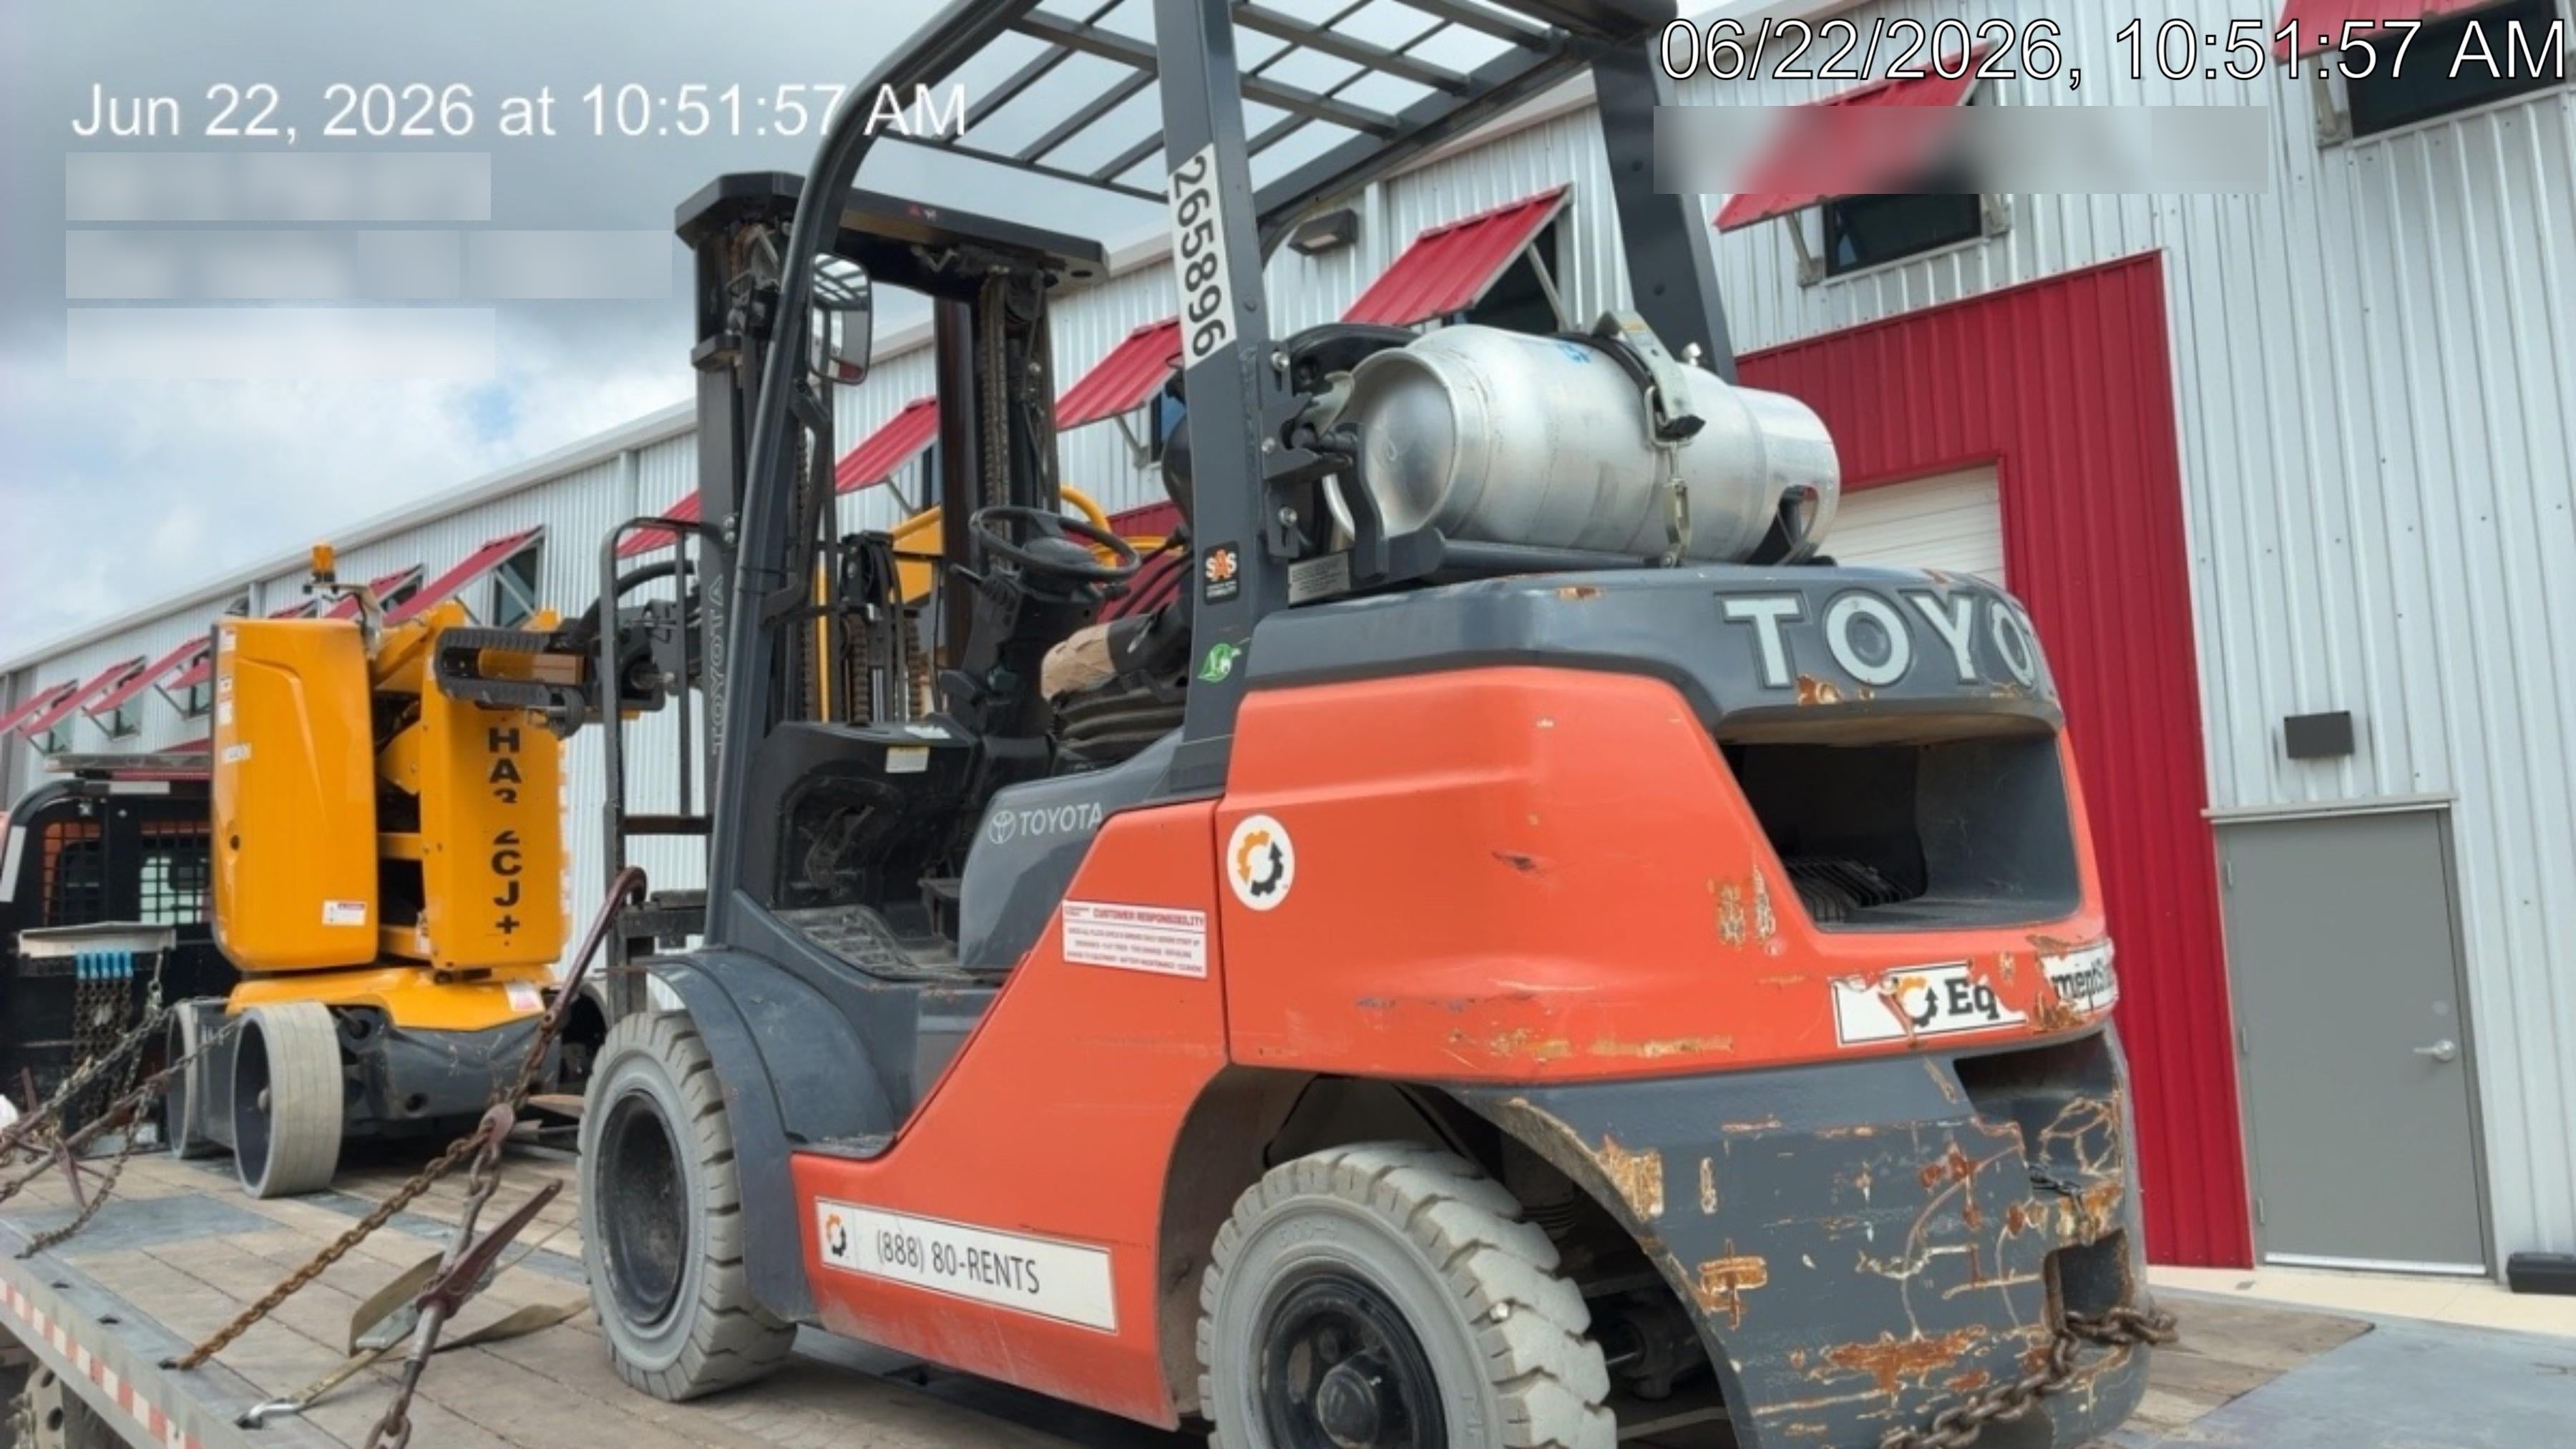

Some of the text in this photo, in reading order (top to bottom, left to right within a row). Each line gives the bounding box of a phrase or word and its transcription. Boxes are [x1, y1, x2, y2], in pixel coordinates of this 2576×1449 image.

[1174, 155, 1226, 357] 265896
[709, 574, 725, 756] TOYOTA
[1019, 801, 1103, 836] TOYOTA
[877, 1229, 1040, 1294] (888) 80-RENTS
